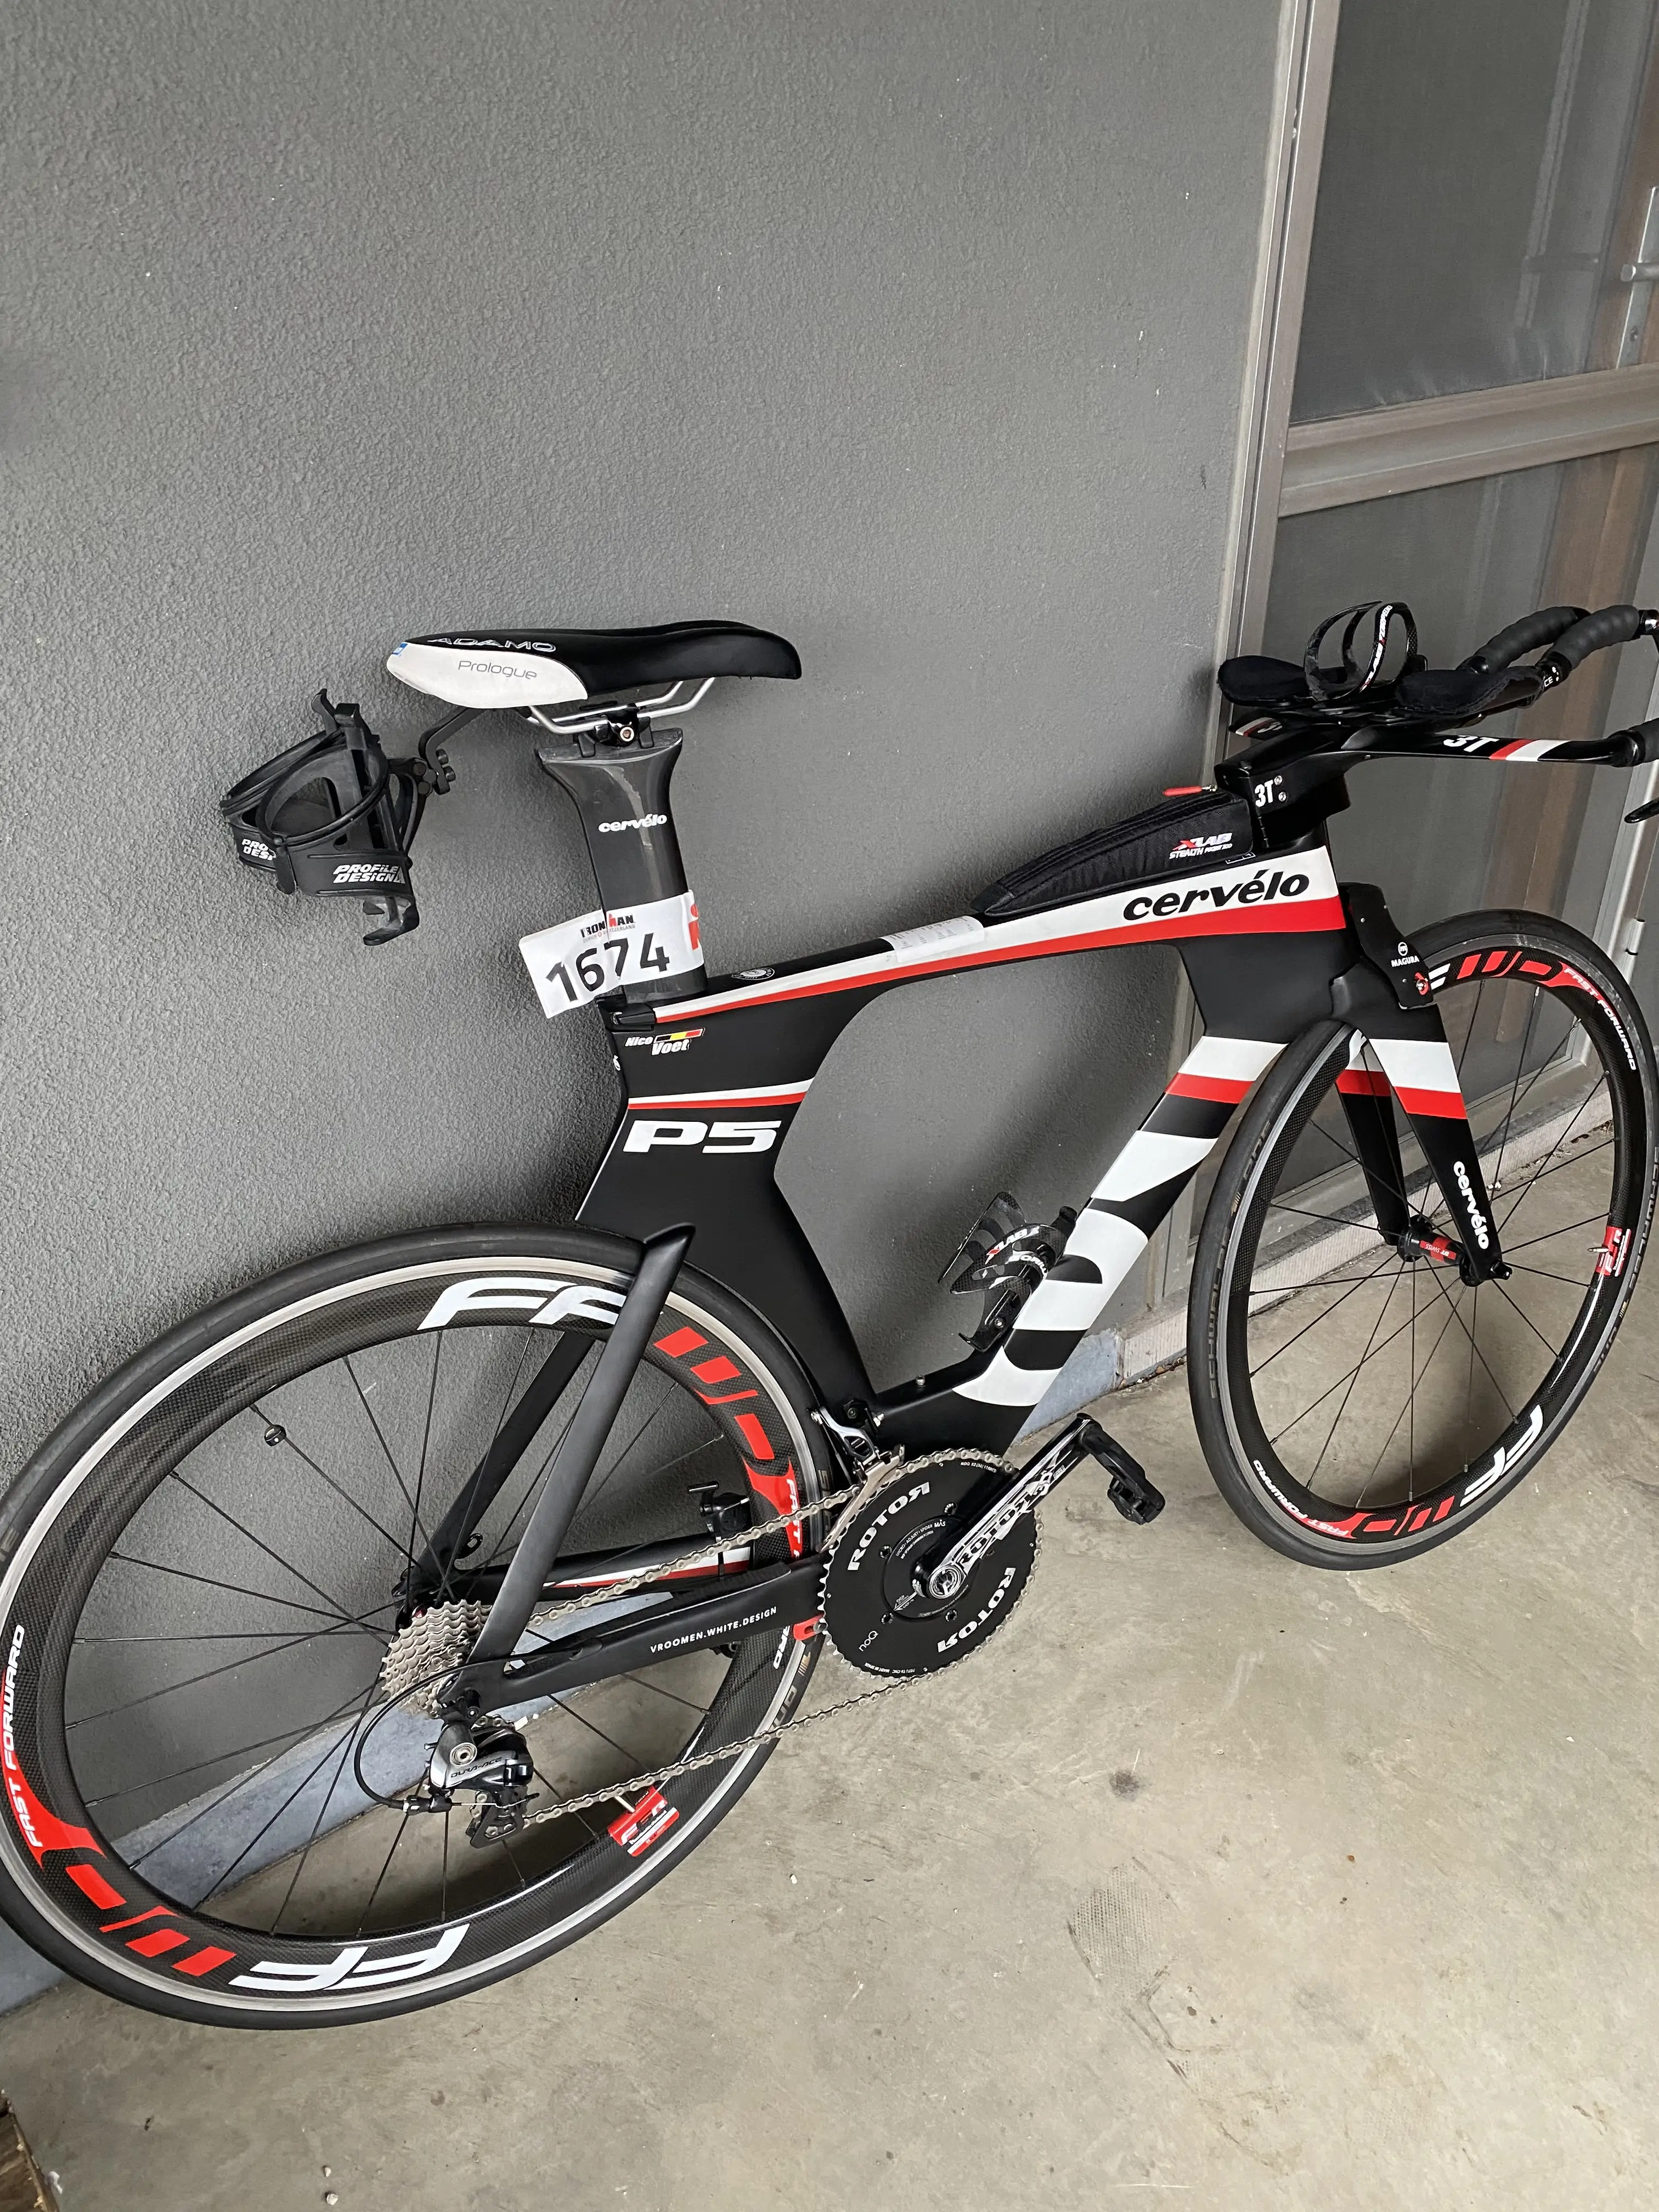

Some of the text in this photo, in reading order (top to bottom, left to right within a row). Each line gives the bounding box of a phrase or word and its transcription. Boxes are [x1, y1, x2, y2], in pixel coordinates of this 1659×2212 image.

[427, 637, 556, 653] ADAMO
[458, 660, 538, 680] Prologue
[1443, 735, 1499, 753] 3T
[1255, 779, 1274, 808] 3T
[598, 814, 667, 833] cervélo
[1169, 847, 1204, 860] STEALTH
[1172, 833, 1233, 851] XLAB
[1123, 869, 1310, 921] cervélo
[545, 933, 670, 1002] 1674
[1391, 955, 1420, 968] MAGURA
[1564, 968, 1637, 1070] FAST FORWARD
[651, 1038, 690, 1056] Voet
[622, 1120, 782, 1154] P5
[1453, 1160, 1489, 1250] cervélo
[1253, 1459, 1350, 1536] FORWARD FAST
[847, 1482, 930, 1571] ROTOR
[937, 1567, 1017, 1653] ROTOR
[650, 1606, 777, 1654] VROOMEN.WHITE.DESIGN
[858, 1630, 879, 1652] noQ
[3, 1624, 43, 1848] FORWARD FAST
